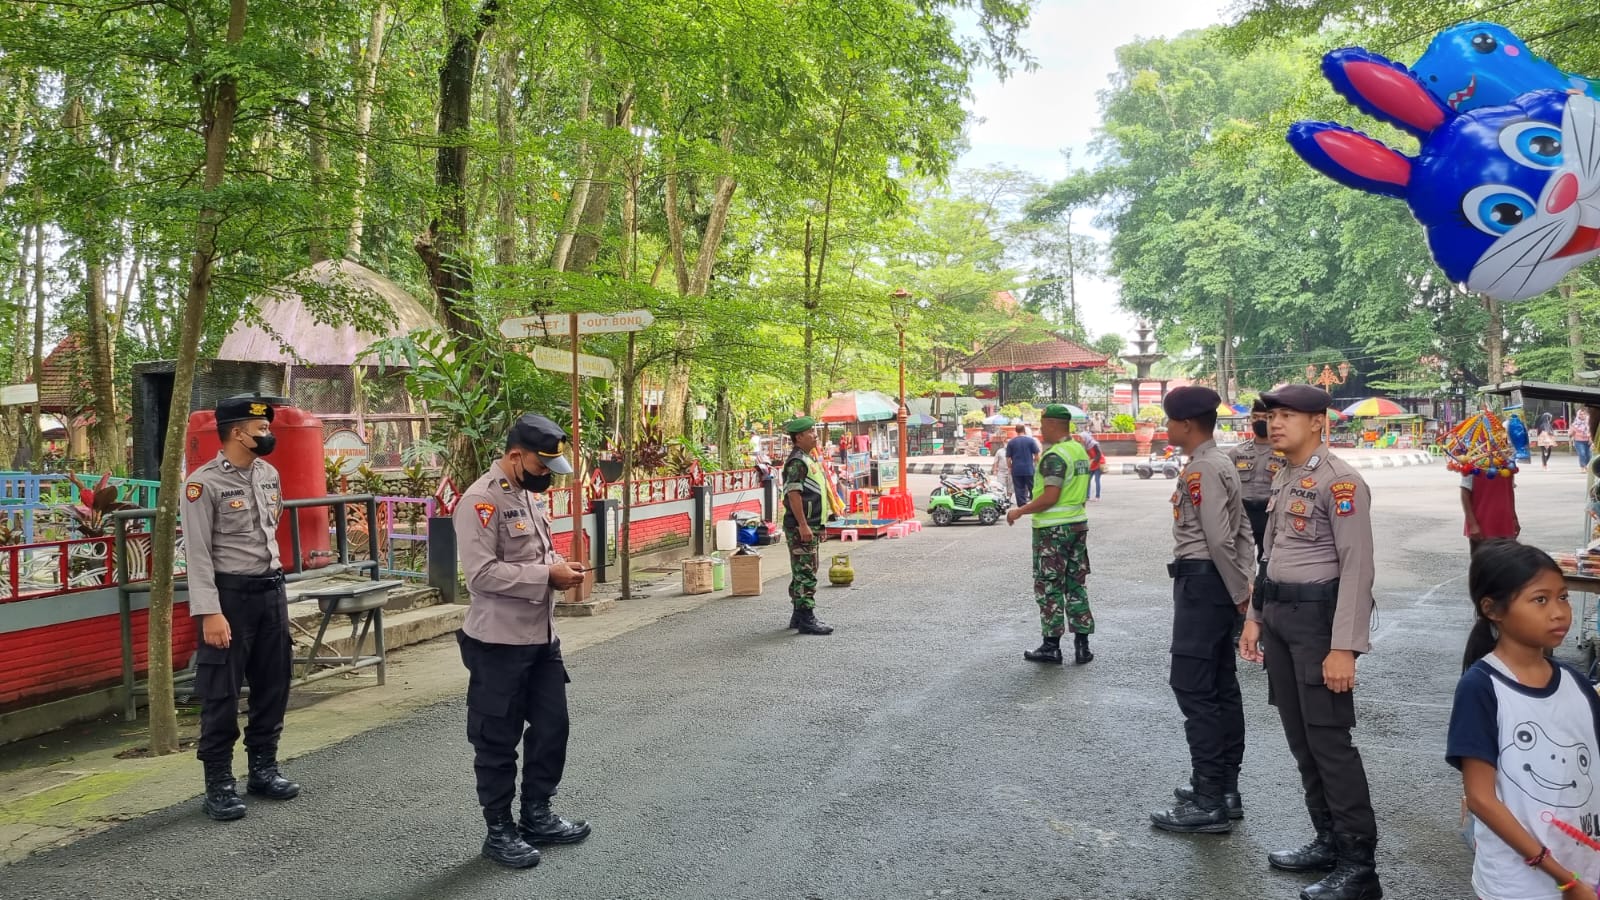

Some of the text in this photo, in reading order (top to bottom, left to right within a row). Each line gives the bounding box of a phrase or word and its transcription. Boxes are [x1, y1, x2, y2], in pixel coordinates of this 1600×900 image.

[587, 316, 642, 327] OUT BOND
[1290, 488, 1317, 500] POLRI
